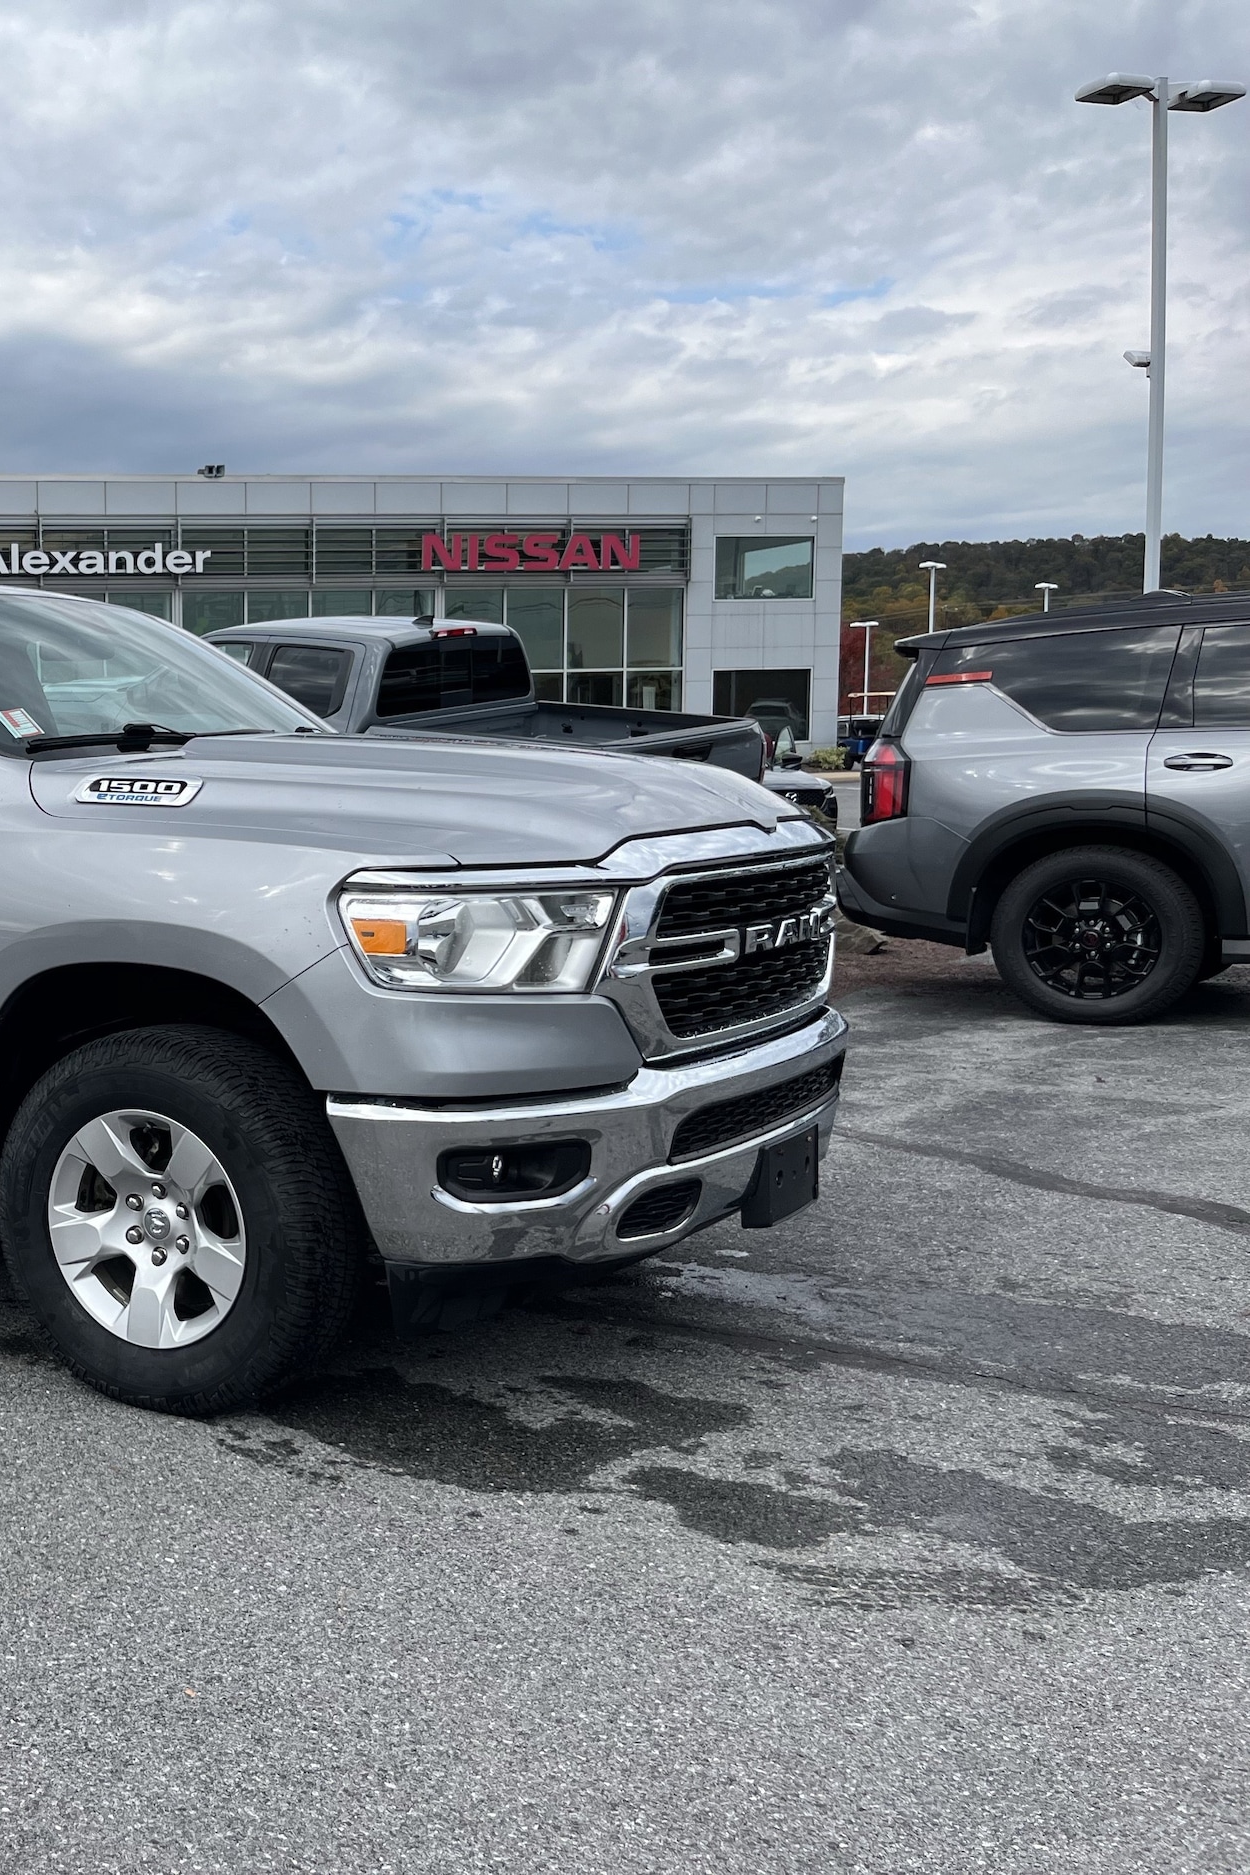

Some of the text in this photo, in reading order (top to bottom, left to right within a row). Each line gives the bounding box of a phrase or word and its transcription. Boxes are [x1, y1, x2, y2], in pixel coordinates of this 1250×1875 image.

[421, 534, 640, 571] NISSAN
[98, 780, 181, 793] 1500
[745, 913, 819, 954] RAM
